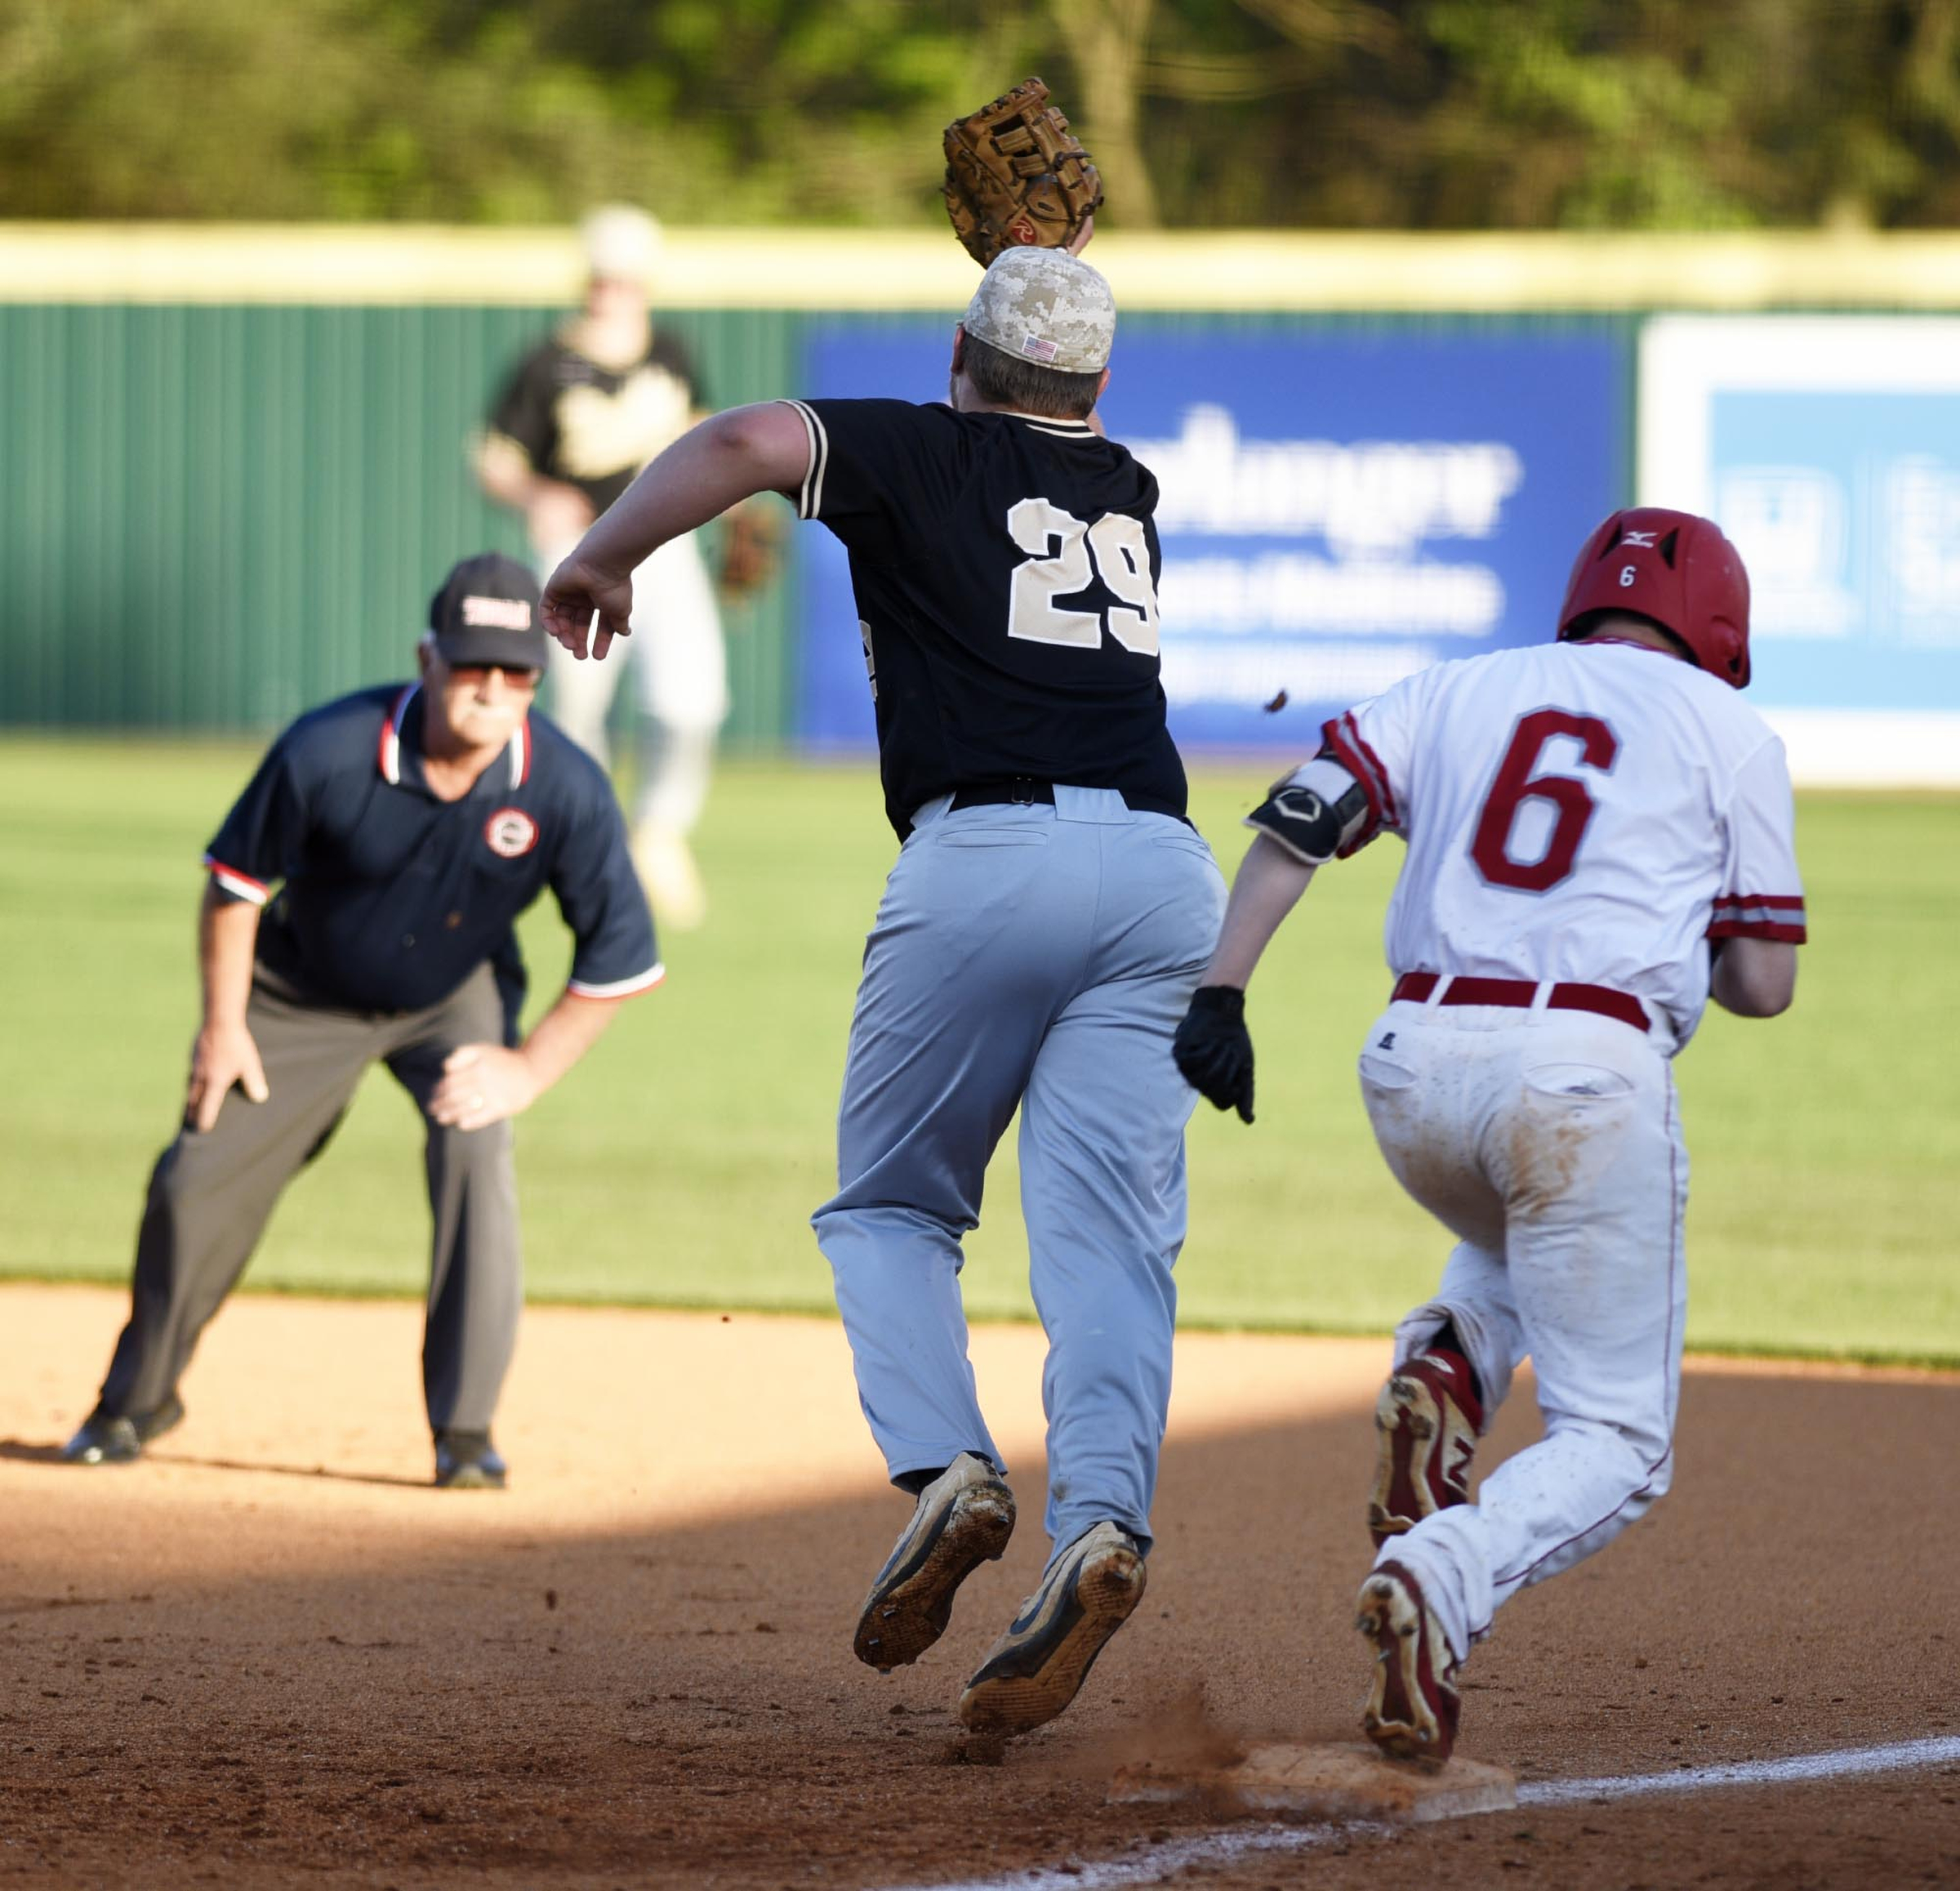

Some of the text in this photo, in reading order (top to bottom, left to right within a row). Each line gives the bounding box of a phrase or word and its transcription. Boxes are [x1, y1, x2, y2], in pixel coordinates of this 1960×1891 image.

[1007, 497, 1160, 657] 29
[1619, 565, 1637, 587] 6
[1465, 704, 1623, 897] 6
